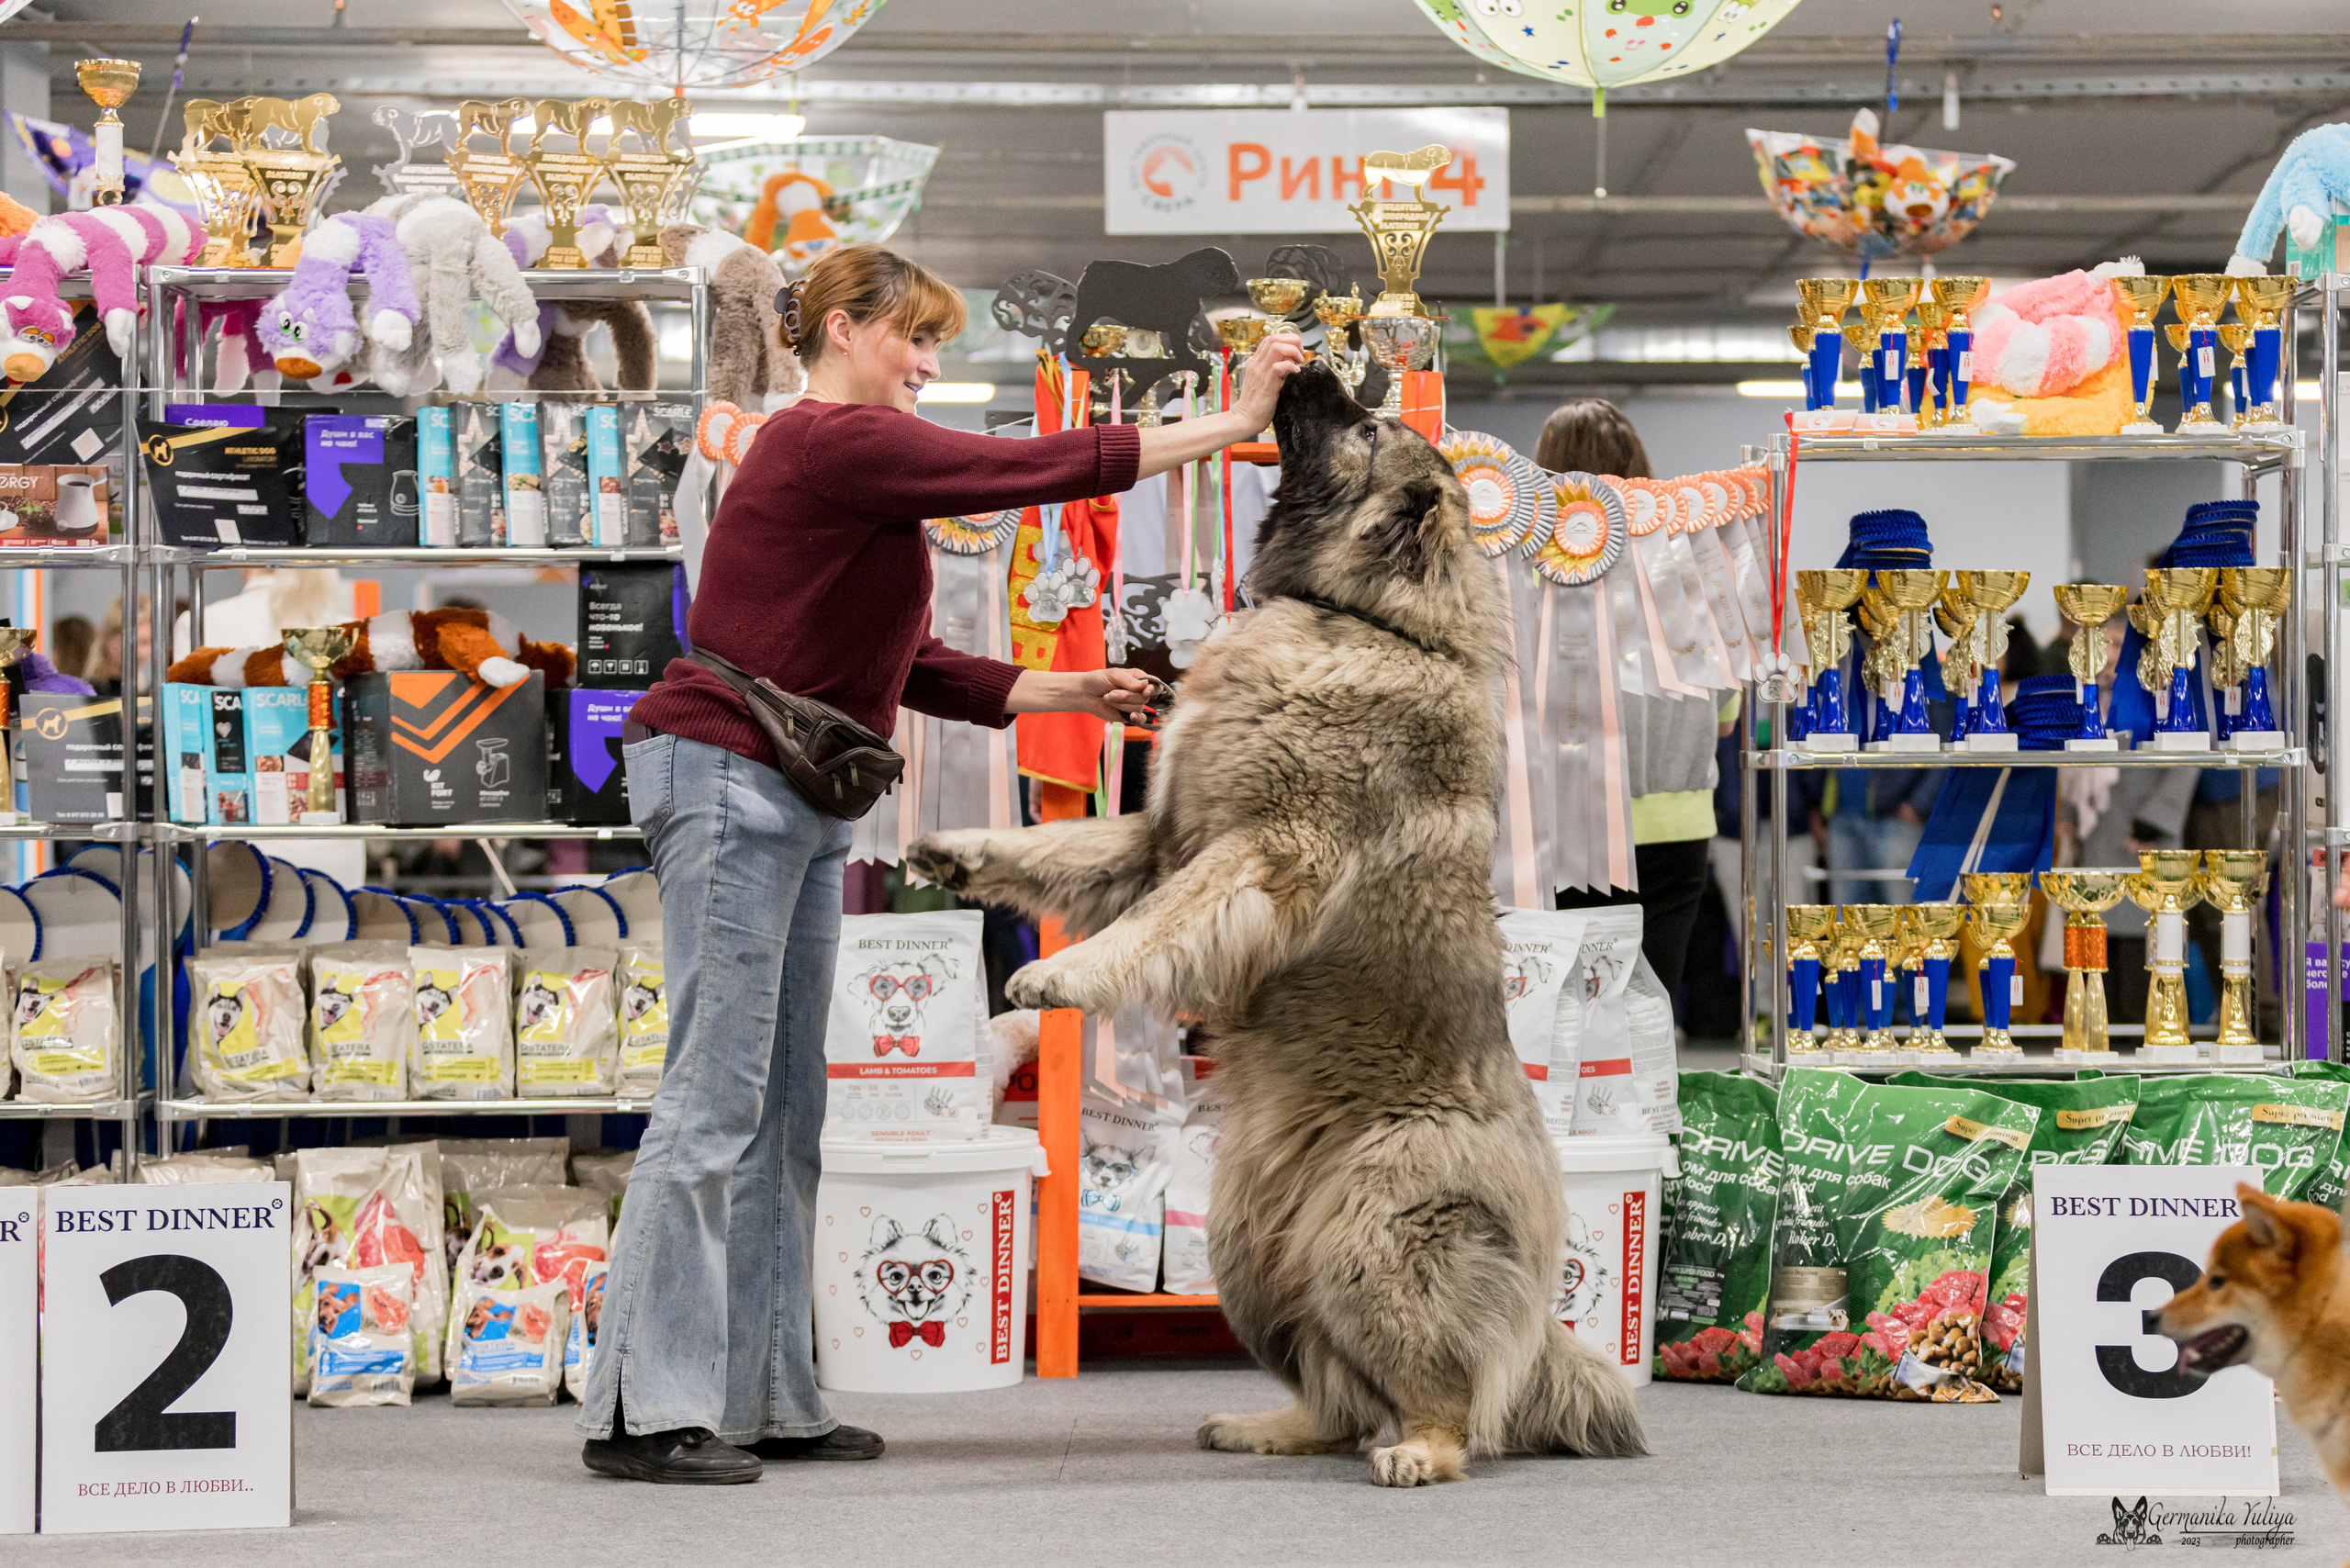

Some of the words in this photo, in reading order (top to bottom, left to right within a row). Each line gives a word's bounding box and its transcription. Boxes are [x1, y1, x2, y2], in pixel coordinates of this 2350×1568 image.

[1228, 142, 1393, 200] Рин
[1429, 141, 1484, 207] 4
[653, 407, 693, 418] SCARLE
[588, 601, 622, 611] Всегда
[588, 613, 621, 622] что-то
[588, 622, 643, 632] новенькое!
[256, 693, 308, 707] SCARL
[858, 939, 893, 949] BEST
[896, 939, 948, 950] DINNER
[1579, 942, 1614, 954] INNER
[1580, 1066, 1595, 1074] OES
[1081, 1107, 1111, 1121] BEST
[1113, 1114, 1156, 1132] DINNER
[2065, 1114, 2092, 1126] Super
[2095, 1109, 2131, 1123] prmium
[2261, 1107, 2288, 1118] Super
[1954, 1120, 1977, 1135] Super
[1680, 1126, 1785, 1178] DRIVE
[1782, 1128, 1895, 1164] DRIVE
[1902, 1144, 1990, 1182] DOG
[2220, 1143, 2315, 1170] DOG
[1684, 1176, 1714, 1195] food
[1705, 1170, 1737, 1184] для
[1739, 1173, 1779, 1196] соба
[1807, 1168, 1843, 1184] для
[1846, 1170, 1892, 1190] собак
[2051, 1197, 2121, 1216] BEST
[2129, 1197, 2240, 1218] DINNER
[56, 1210, 137, 1233] BEST
[147, 1206, 274, 1231] DINNER
[998, 1198, 1012, 1293] DINNER
[1628, 1199, 1642, 1294] DINNER
[1788, 1230, 1820, 1246] Rober
[1696, 1270, 1715, 1278] FOOD
[996, 1303, 1009, 1361] BEST
[1626, 1301, 1639, 1361] BEST
[2095, 1251, 2213, 1399] 3
[95, 1254, 236, 1452] 2
[2067, 1444, 2102, 1457] ВСЕ
[2107, 1444, 2156, 1459] ДЕЛО
[2162, 1445, 2174, 1457] В
[2179, 1445, 2252, 1458] ЛЮБВИ!
[78, 1483, 110, 1496] ВСЕ
[114, 1481, 161, 1498] ДЕЛО
[166, 1481, 175, 1494] В
[181, 1479, 254, 1494] ЛЮБВИ..
